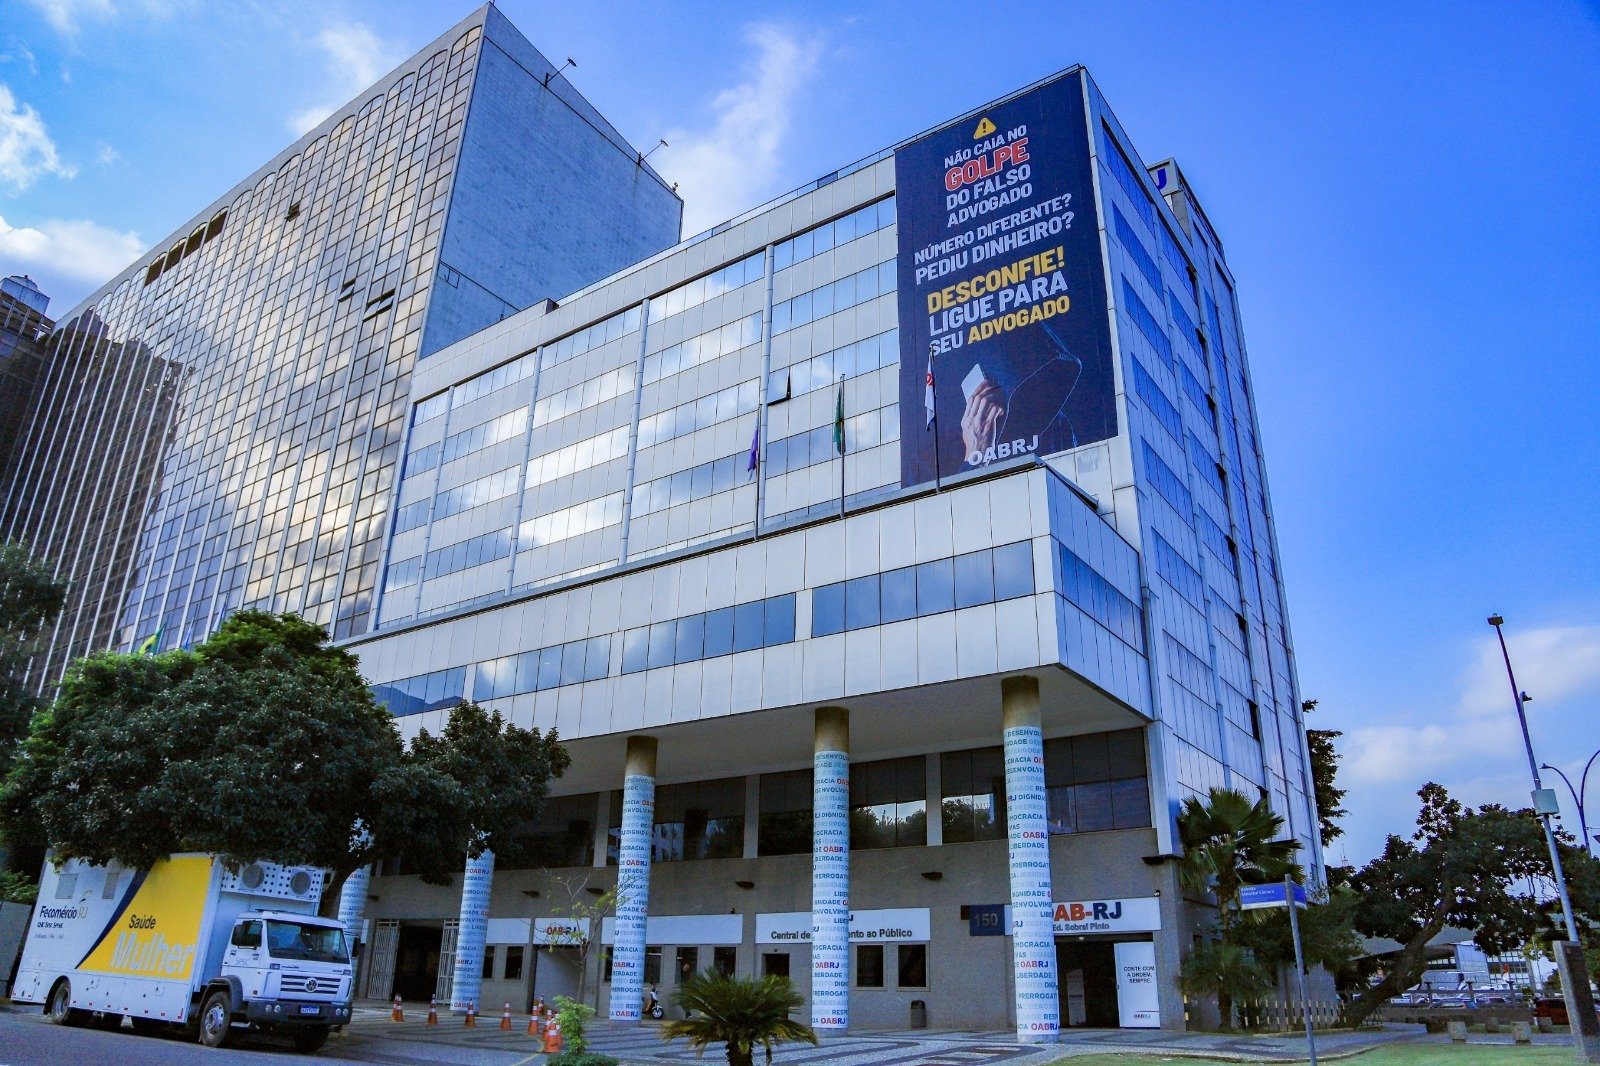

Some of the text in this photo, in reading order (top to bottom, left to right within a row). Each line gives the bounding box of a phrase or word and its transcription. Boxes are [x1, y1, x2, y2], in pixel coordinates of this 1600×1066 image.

[944, 125, 1027, 169] NÃO CAIA NO
[945, 137, 1030, 191] GOLPE
[947, 164, 1031, 211] DO FALSO
[947, 183, 1033, 228] ADVOGADO
[914, 193, 1072, 265] NÚMERO DIFERENTE?
[915, 211, 1075, 286] PEDIU DINHEIRO?
[927, 245, 1065, 314] DESCONFIE!
[929, 271, 1069, 337] LIGUE PARA
[929, 295, 1071, 357] SEU ADVOGADO
[967, 435, 1039, 466] OABRJ
[40, 905, 77, 919] Fecomércio
[128, 914, 157, 929] Saúde
[973, 912, 999, 928] 150
[1052, 901, 1122, 921] AB-RJ
[770, 931, 799, 940] Central
[800, 930, 811, 939] de
[866, 930, 877, 938] ao
[879, 927, 913, 938] Público
[1065, 923, 1089, 931] Sobral
[1090, 922, 1110, 930] Pinto
[110, 931, 196, 976] Mulher
[815, 961, 840, 969] OABRJ
[1020, 960, 1049, 968] OABRJ
[616, 1010, 638, 1018] OABRJ
[820, 1017, 846, 1025] OABRJ
[1031, 1022, 1058, 1031] OABRJ
